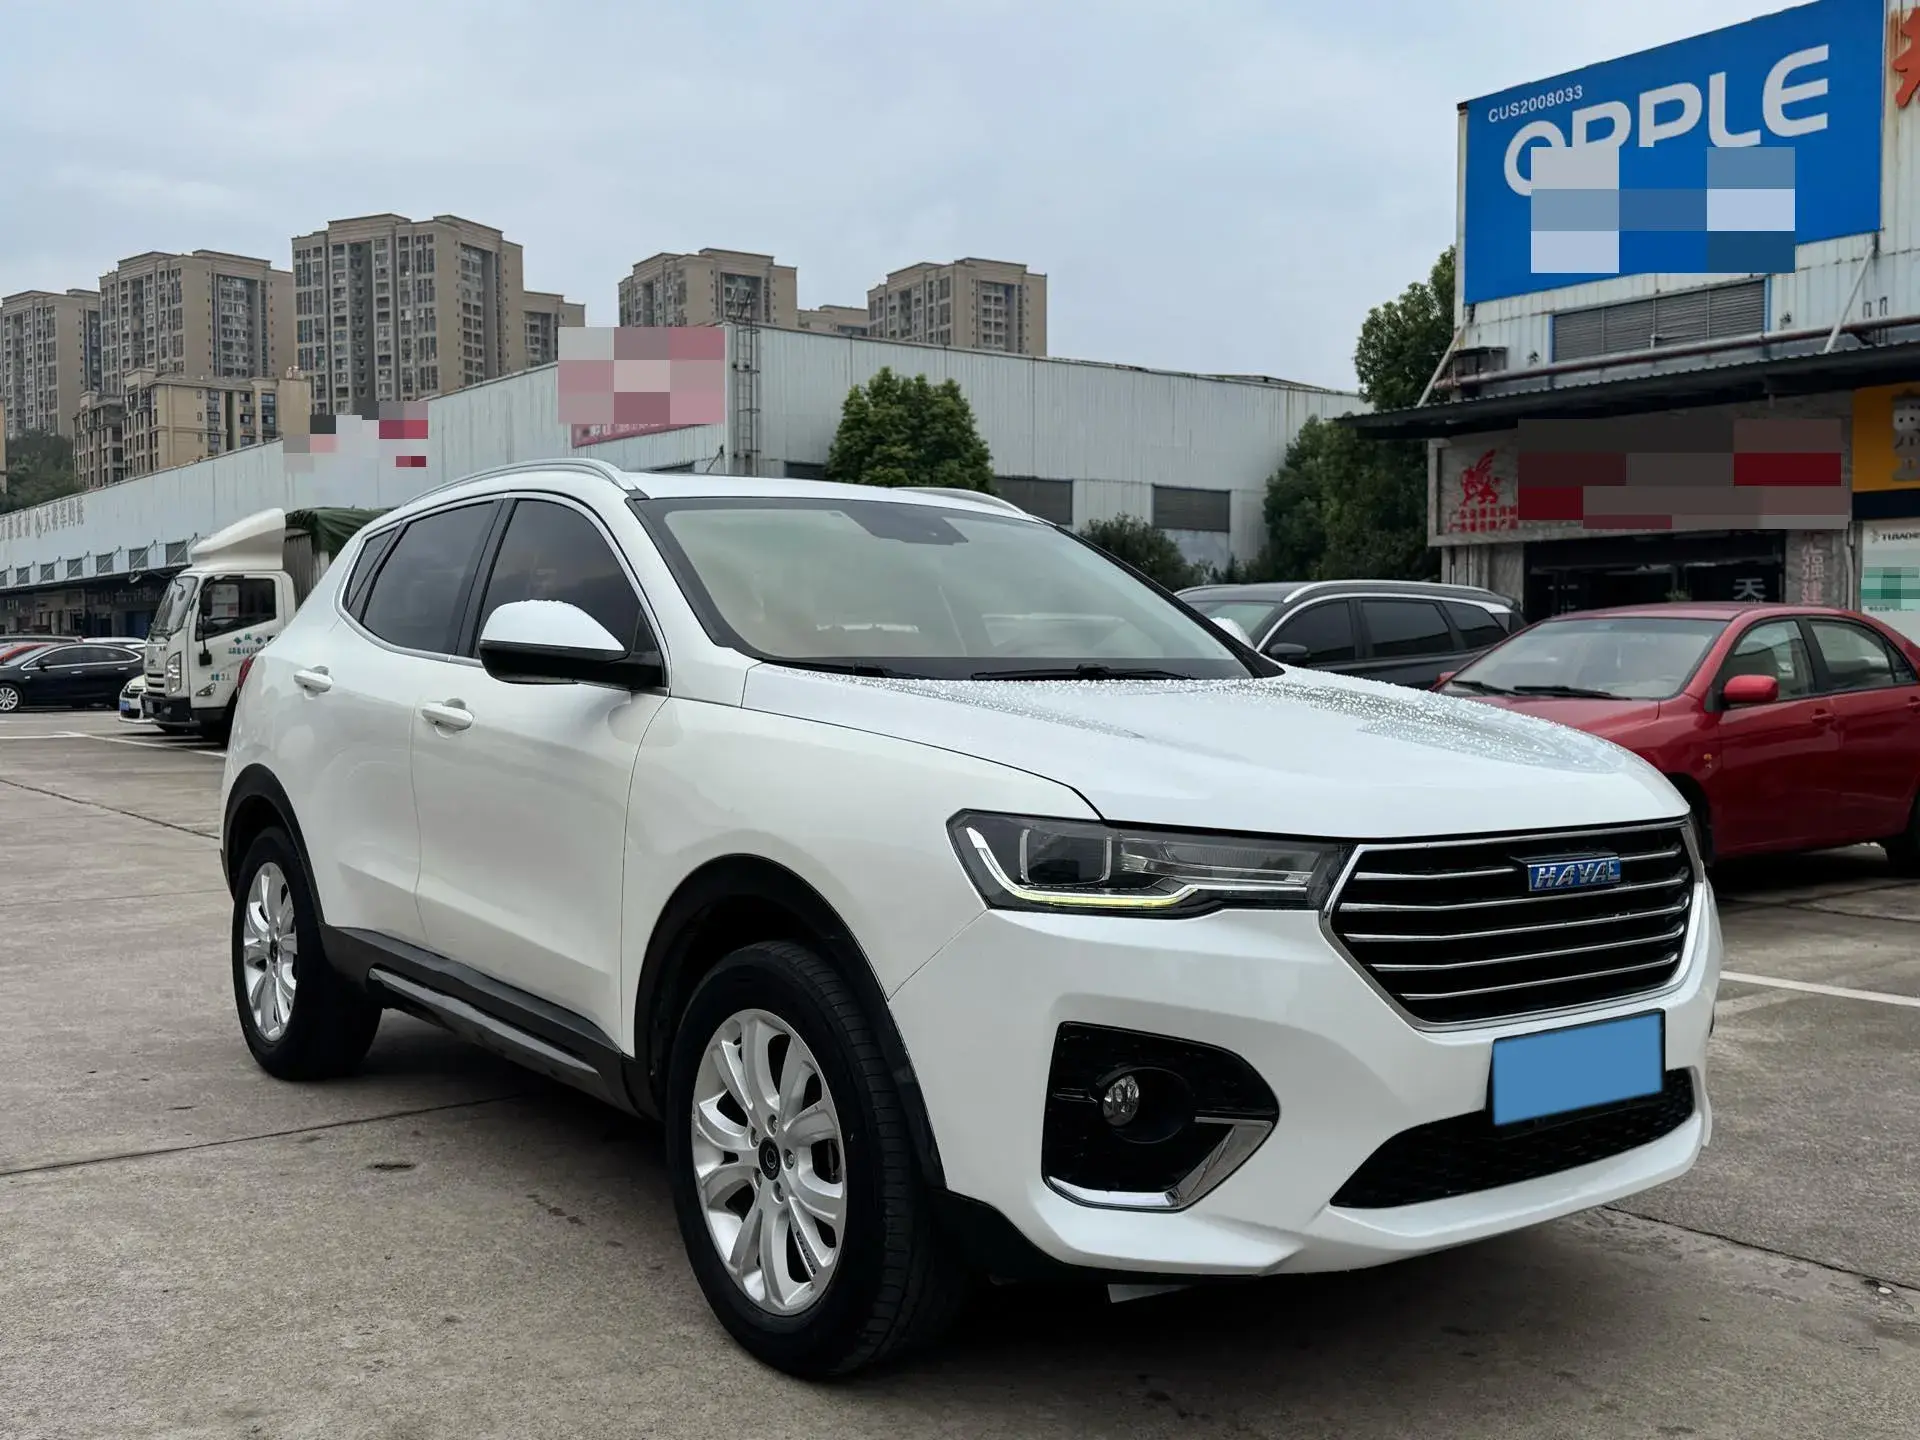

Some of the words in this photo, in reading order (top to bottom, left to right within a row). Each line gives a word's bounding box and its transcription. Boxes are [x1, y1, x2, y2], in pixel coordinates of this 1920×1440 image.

[1487, 84, 1584, 123] CUS2008033
[1503, 43, 1830, 197] OPPLE
[1534, 860, 1621, 888] HAVAL
